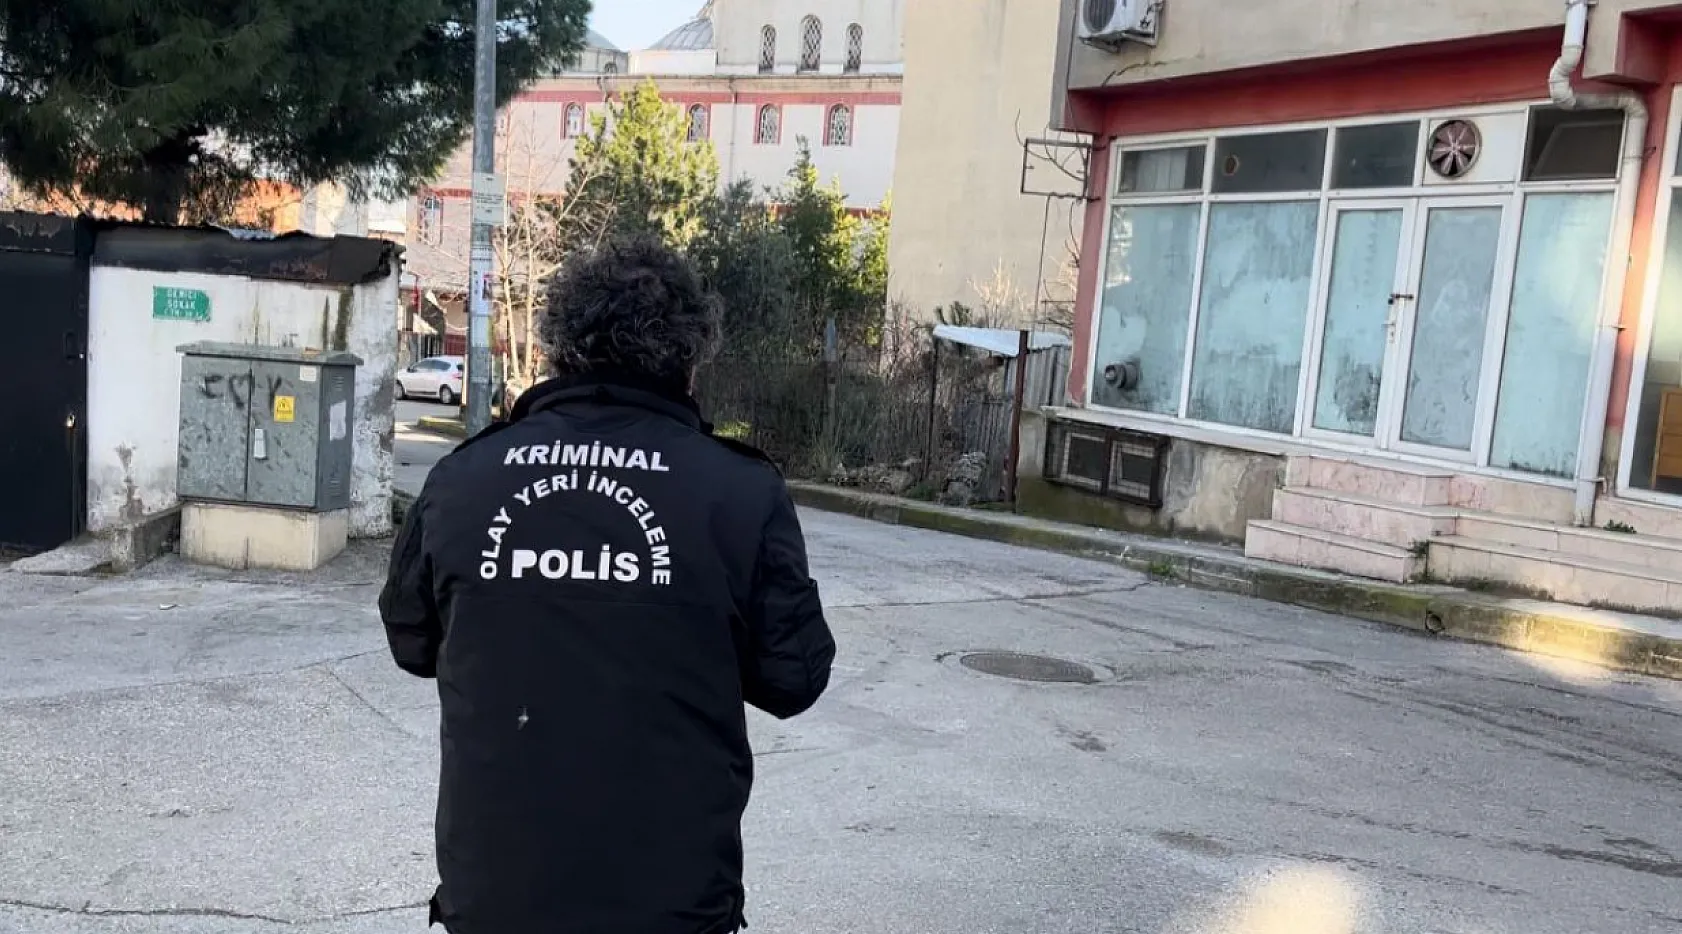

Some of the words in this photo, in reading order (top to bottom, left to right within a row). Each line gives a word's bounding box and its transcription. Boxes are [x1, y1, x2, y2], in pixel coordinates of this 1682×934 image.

[503, 440, 670, 472] KRİMİNAL
[480, 506, 512, 580] OLAY
[513, 469, 579, 507] YERİ
[586, 470, 672, 586] İNCELEME
[511, 544, 640, 582] POLİS
